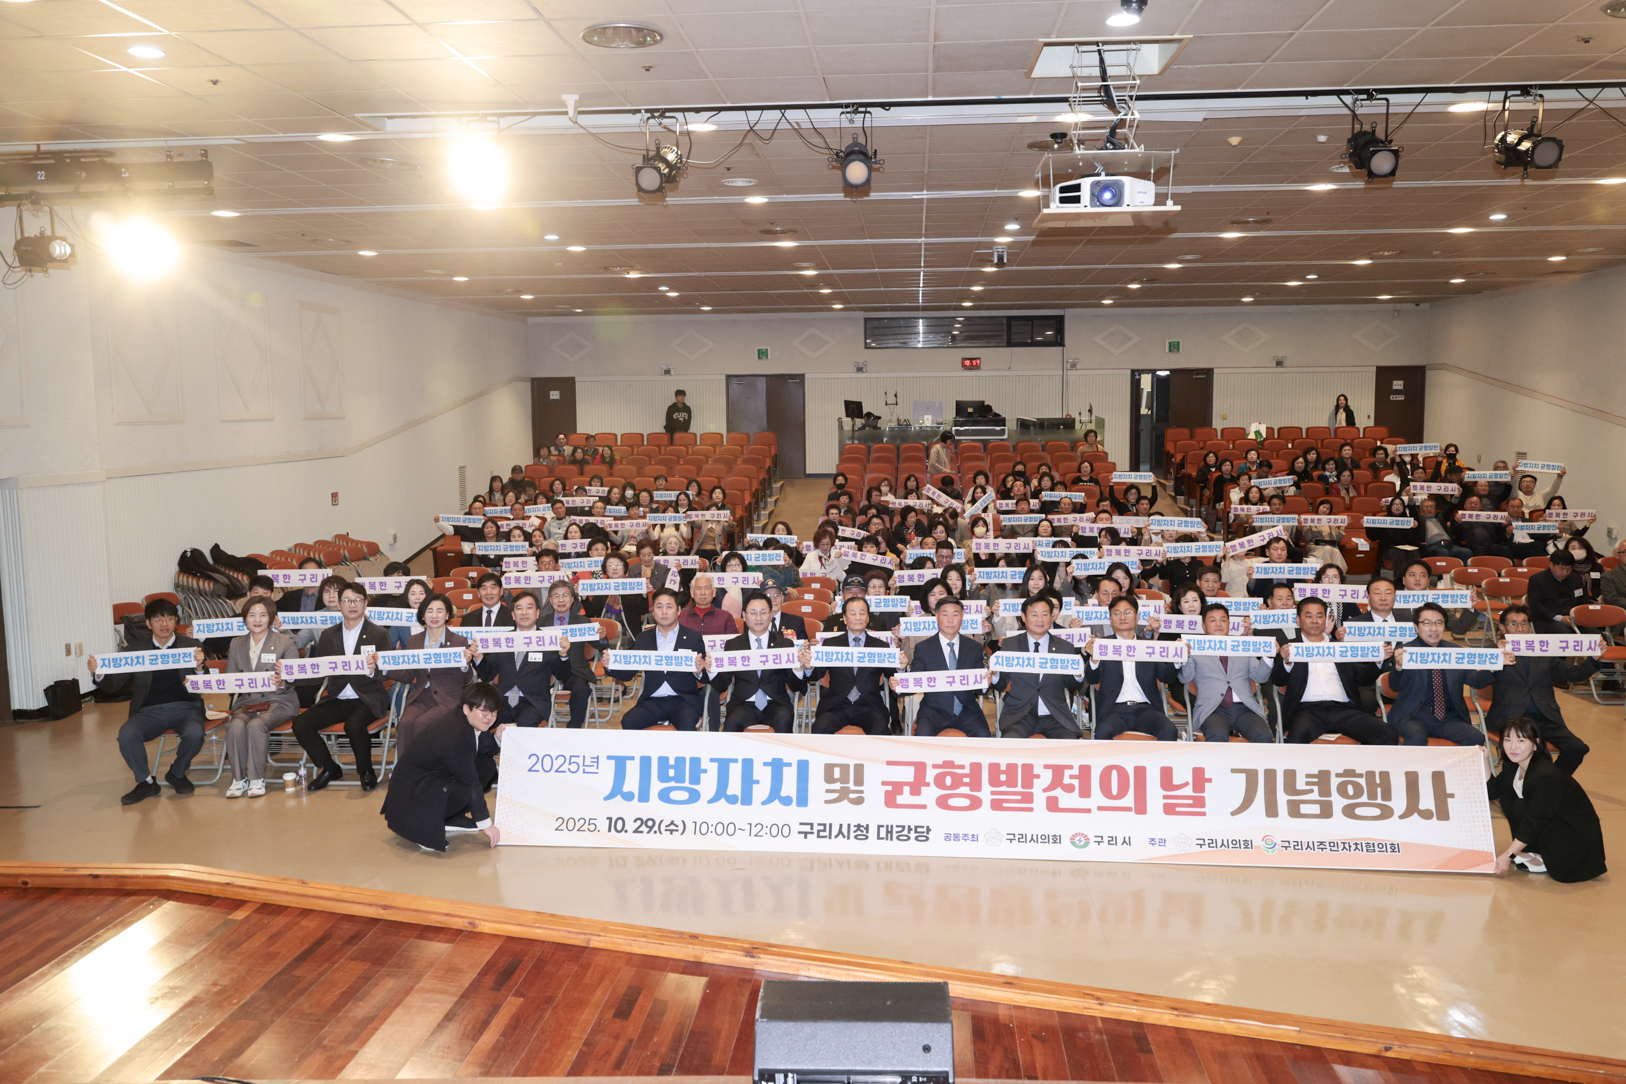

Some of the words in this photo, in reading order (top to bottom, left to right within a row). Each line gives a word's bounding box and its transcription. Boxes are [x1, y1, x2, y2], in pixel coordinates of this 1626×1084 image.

[37, 170, 46, 180] 22
[582, 583, 611, 591] 지방자치
[614, 582, 643, 591] 균형발전
[1299, 588, 1330, 598] 행복한
[1432, 594, 1467, 604] 균형발전
[875, 598, 906, 608] 균형발전
[1225, 601, 1259, 611] 균형발전
[964, 605, 982, 614] 리시
[282, 616, 317, 625] 지방자치
[369, 611, 402, 621] 지방자치
[1076, 611, 1109, 621] 지방자치
[1253, 614, 1289, 624] 지방자치
[197, 622, 233, 633] 지방자치
[1164, 619, 1197, 630] 행복한
[1347, 626, 1385, 637] 지방자치
[480, 637, 514, 649] 행복한
[523, 636, 558, 647] 구리시
[1186, 639, 1227, 651] 지방자치
[1231, 640, 1272, 653] 균형발전
[1511, 640, 1549, 652] 행복한
[1560, 640, 1597, 652] 구리시
[815, 651, 854, 662] 지방자치
[857, 652, 896, 663] 균형발전
[1099, 644, 1136, 657] 행복한
[1146, 646, 1183, 658] 구리시
[1294, 646, 1336, 658] 지방자치
[1339, 646, 1380, 658] 균형발전
[100, 655, 145, 668] 지방자치
[149, 652, 192, 665] 균형발전
[382, 654, 420, 665] 지방자치
[423, 652, 462, 664] 균형발전
[613, 654, 651, 665] 지방자치
[655, 655, 693, 667] 균형발전
[715, 656, 750, 668] 행복한
[760, 653, 795, 665] 구리시
[995, 656, 1035, 668] 지방자치
[1039, 657, 1080, 670] 균형발전
[1408, 652, 1451, 664] 지방자치
[1455, 653, 1499, 665] 균형발전
[284, 663, 320, 675] 행복한
[329, 660, 364, 671] 구리시
[190, 679, 225, 690] 행복한
[235, 677, 271, 689] 구리시
[900, 677, 936, 689] 행복한
[946, 674, 983, 686] 구리시
[527, 753, 600, 775] 2025년
[603, 755, 810, 808] 지방자치
[823, 762, 866, 806] 및
[881, 760, 1148, 816] 균형발전의
[1159, 765, 1213, 817] 날
[1230, 768, 1456, 822] 기념행사
[554, 816, 601, 832] 2025.
[605, 816, 629, 834] 10.
[692, 820, 792, 839] 10:00~12:00
[797, 821, 870, 841] 구리시청
[876, 824, 932, 843] 대강당
[943, 832, 979, 843] 공동주최
[1005, 832, 1062, 846] 구리시의회
[1148, 837, 1167, 848] 주관
[1195, 837, 1254, 851] 구리시의회
[1280, 839, 1401, 855] 구리시주민자치협의회
